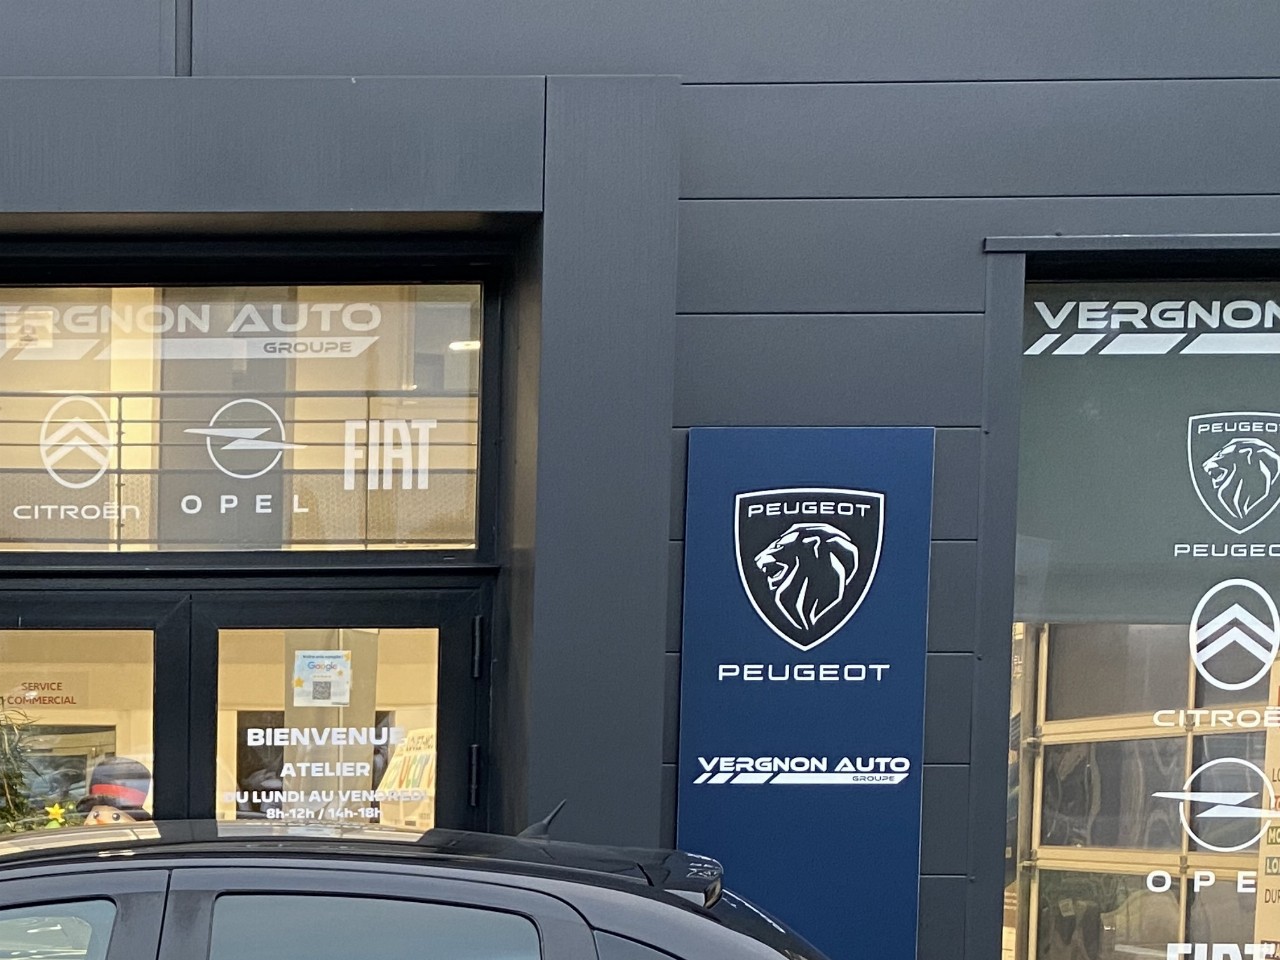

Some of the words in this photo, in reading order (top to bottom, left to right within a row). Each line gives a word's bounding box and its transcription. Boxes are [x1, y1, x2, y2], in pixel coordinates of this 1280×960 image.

[226, 302, 383, 334] AUTO
[263, 341, 352, 354] GROUPE
[1198, 422, 1280, 434] PEUGEO
[342, 418, 438, 491] FIAT
[180, 494, 309, 515] OPEL
[748, 501, 871, 517] PEUGEOT
[307, 661, 338, 671] Google
[718, 664, 890, 681] PEUGEOT
[21, 682, 63, 691] SERVICE
[7, 696, 77, 704] COMMERCIAL
[247, 727, 406, 746] BIENVENUE
[280, 762, 370, 777] ATELIER
[697, 757, 827, 772] VERGNON
[834, 757, 911, 772] AUTO
[252, 790, 305, 803] LUNDI
[308, 790, 334, 803] AU
[338, 789, 428, 802] VENDREDI
[266, 807, 315, 819] 8h-12h
[329, 807, 382, 819] 14h-18h
